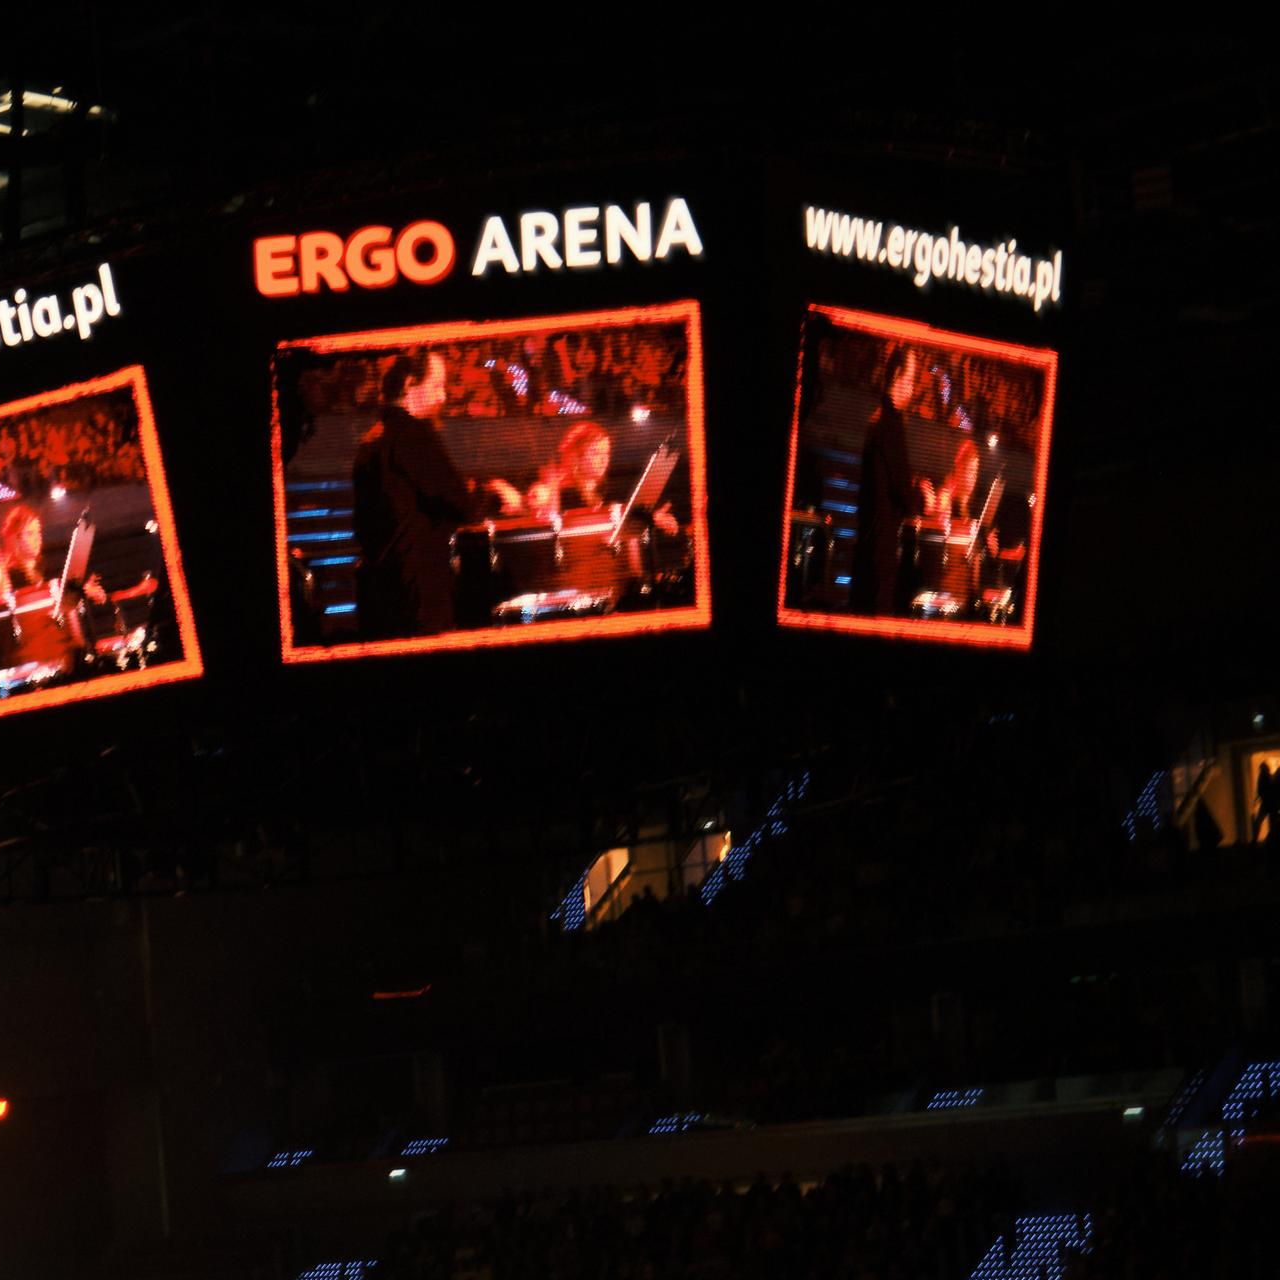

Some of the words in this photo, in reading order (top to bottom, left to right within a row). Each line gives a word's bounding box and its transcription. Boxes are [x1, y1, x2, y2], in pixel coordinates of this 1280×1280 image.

[252, 219, 457, 299] ERGO
[471, 197, 704, 276] ARENA
[805, 205, 1063, 312] www.ergohestia.pl
